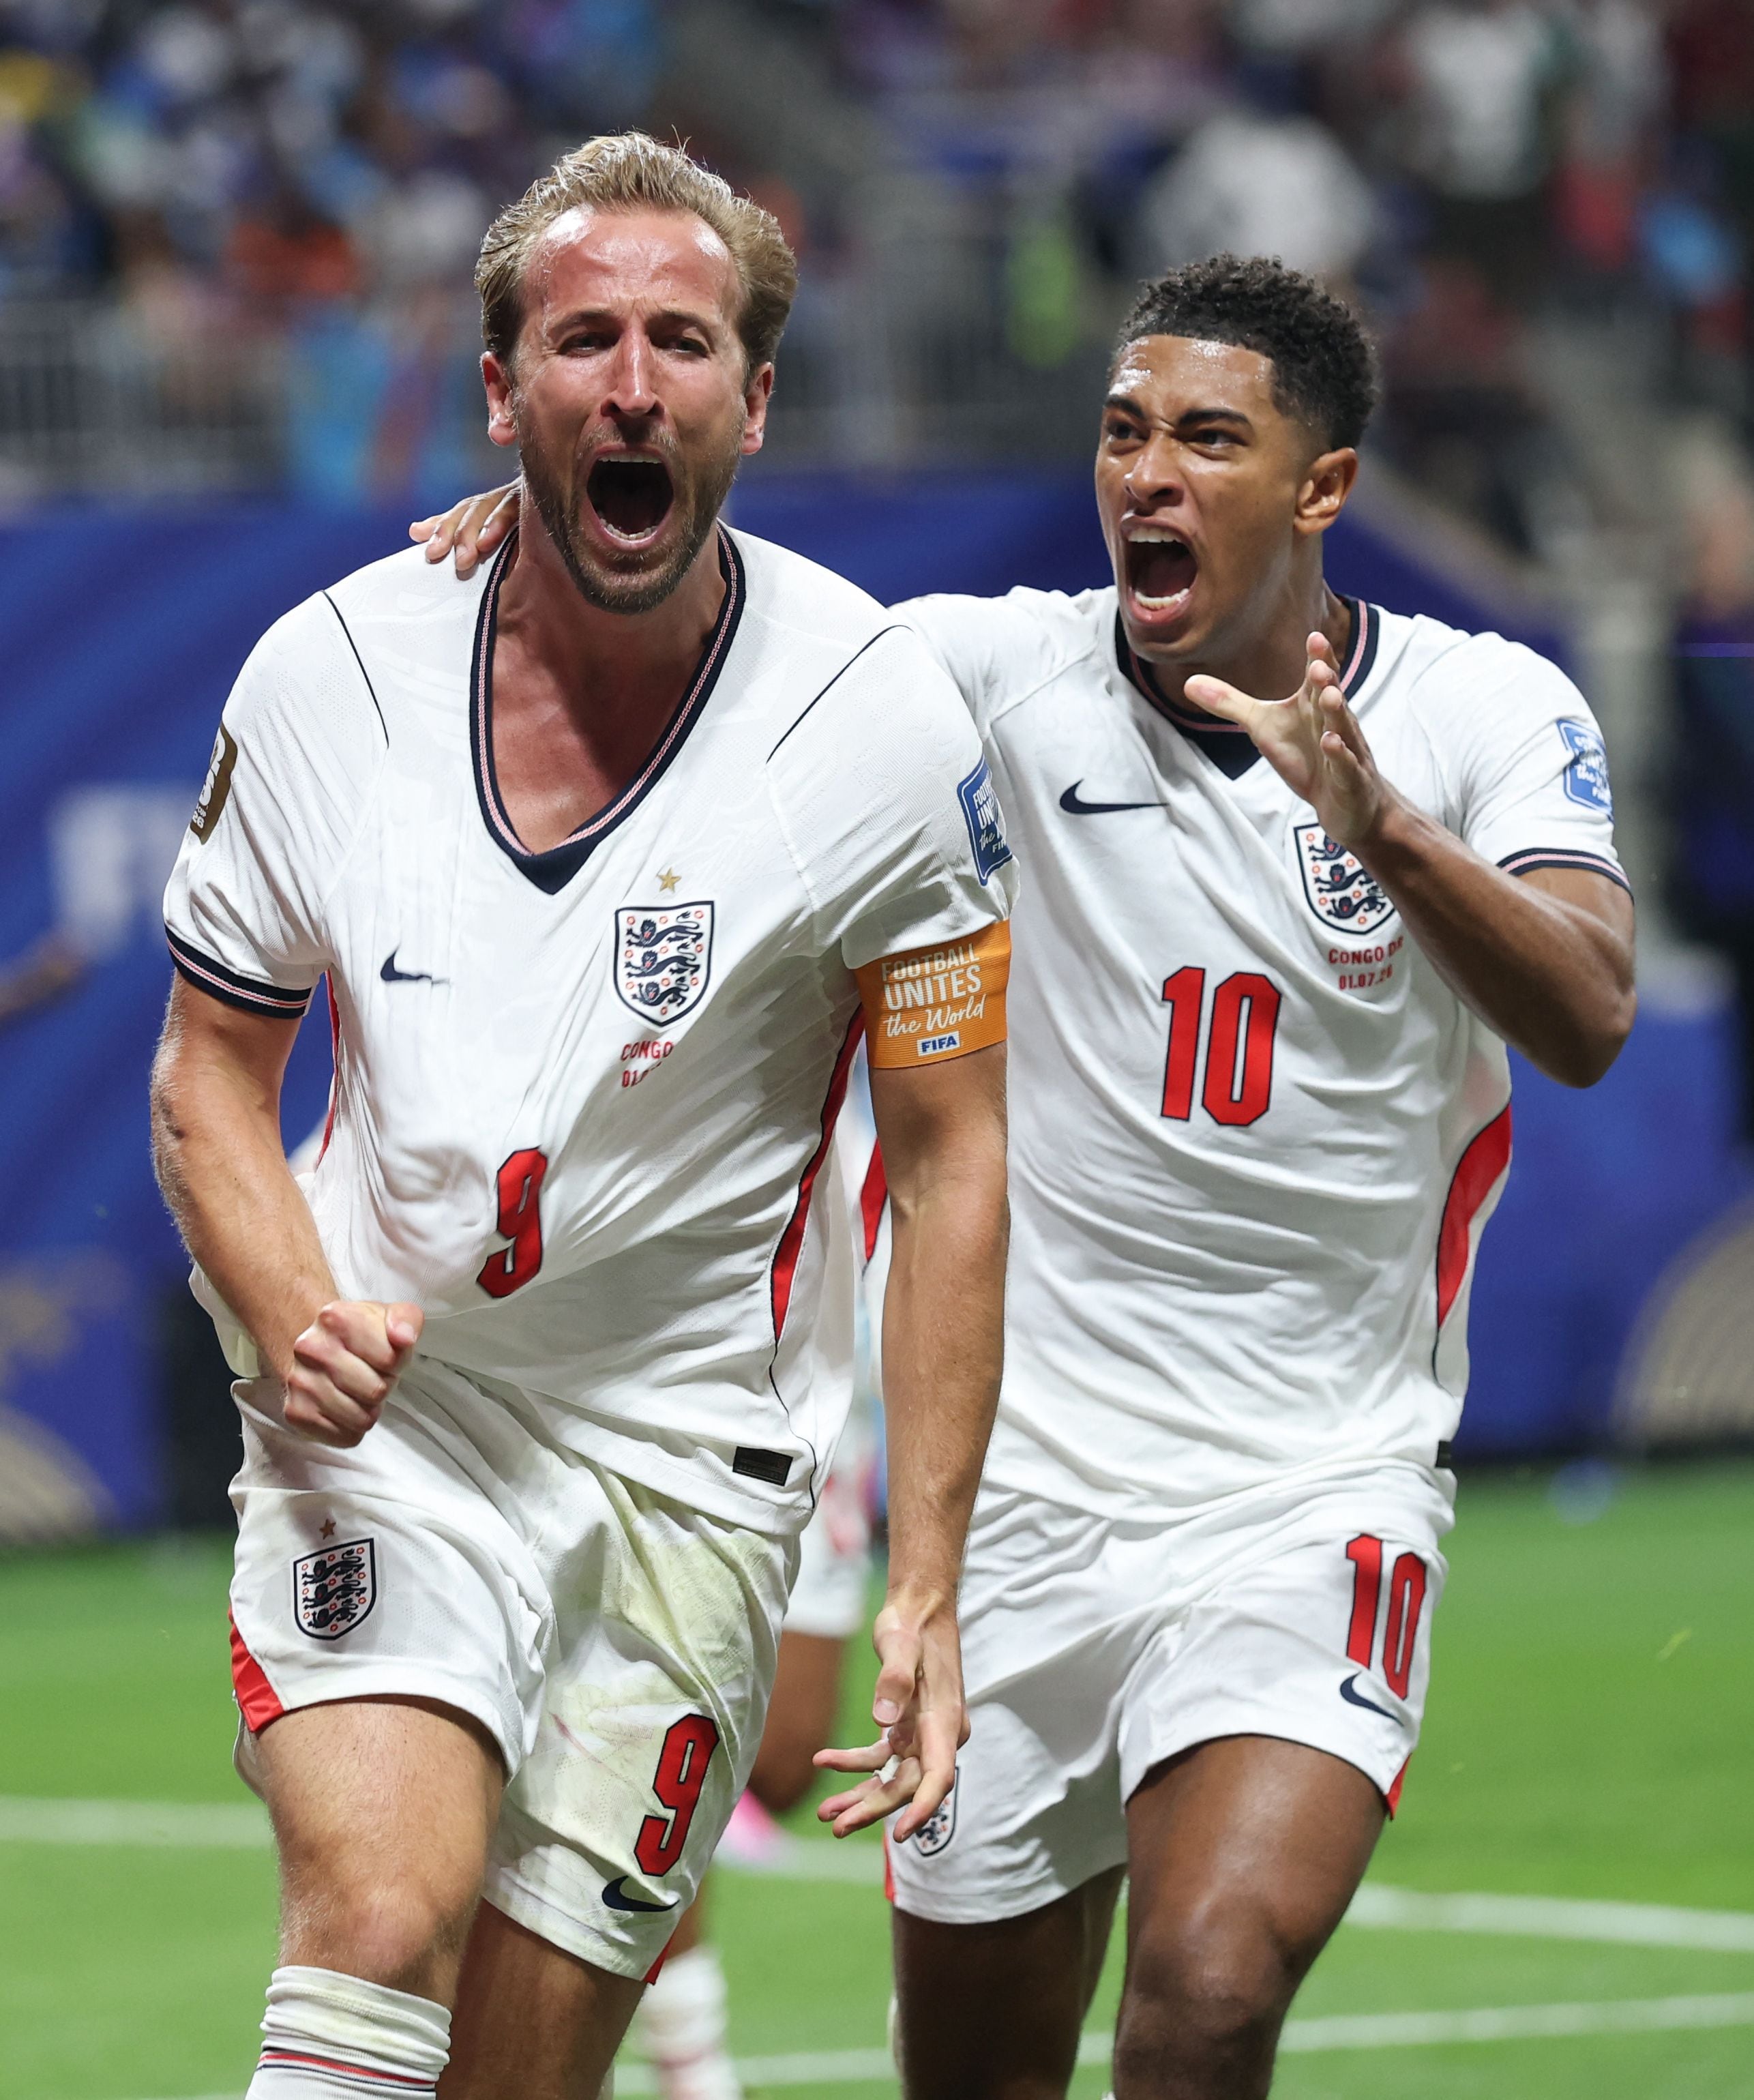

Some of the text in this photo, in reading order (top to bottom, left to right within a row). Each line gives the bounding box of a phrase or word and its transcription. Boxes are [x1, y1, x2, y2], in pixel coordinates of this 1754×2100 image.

[192, 810, 205, 829] 26
[198, 805, 207, 817] CUP
[882, 943, 980, 981] FOOTBALL
[1328, 946, 1384, 964] CONGO
[885, 965, 982, 1011] UNITES
[882, 993, 987, 1037] the World
[621, 1041, 674, 1061] CONGO
[921, 1035, 957, 1053] FIFA
[1160, 965, 1282, 1128] 10
[475, 1144, 549, 1299] 9
[1345, 1532, 1427, 1701] 10
[633, 1712, 720, 1878] 9
